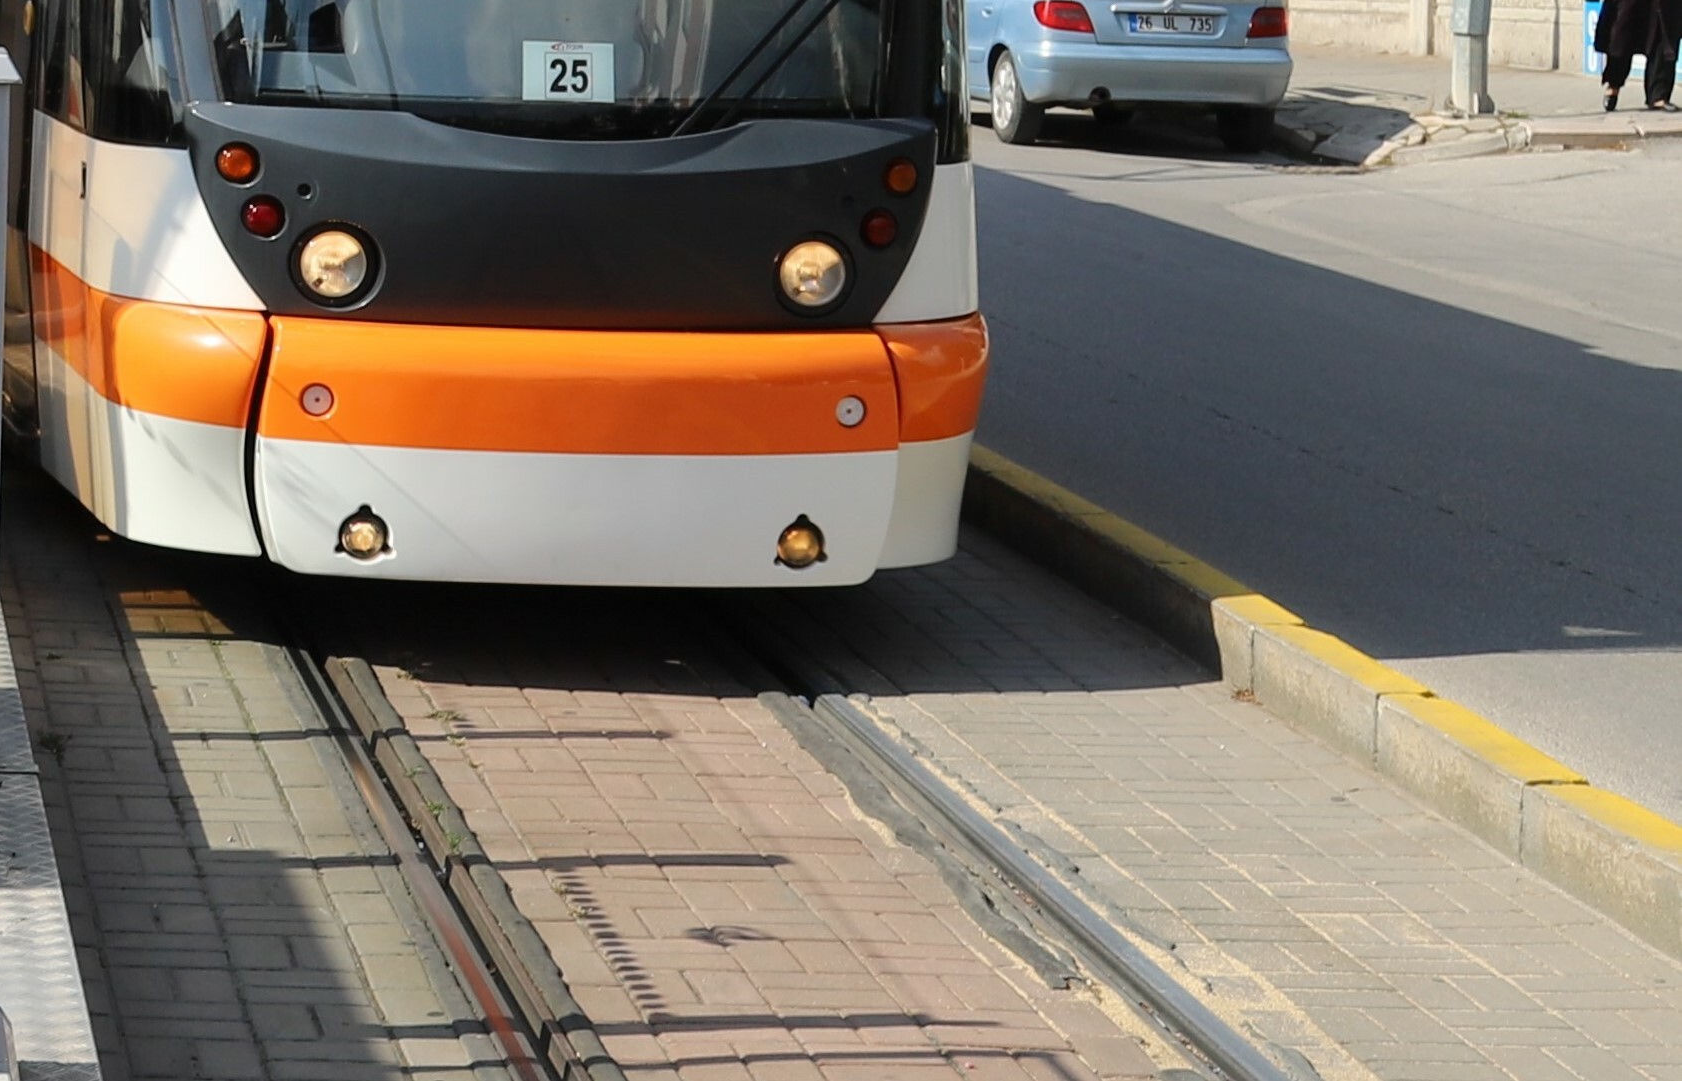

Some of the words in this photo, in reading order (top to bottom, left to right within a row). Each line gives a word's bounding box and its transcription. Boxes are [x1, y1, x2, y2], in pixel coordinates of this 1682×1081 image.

[1138, 15, 1153, 30] 26
[1190, 17, 1212, 32] 735
[549, 58, 589, 94] 25
